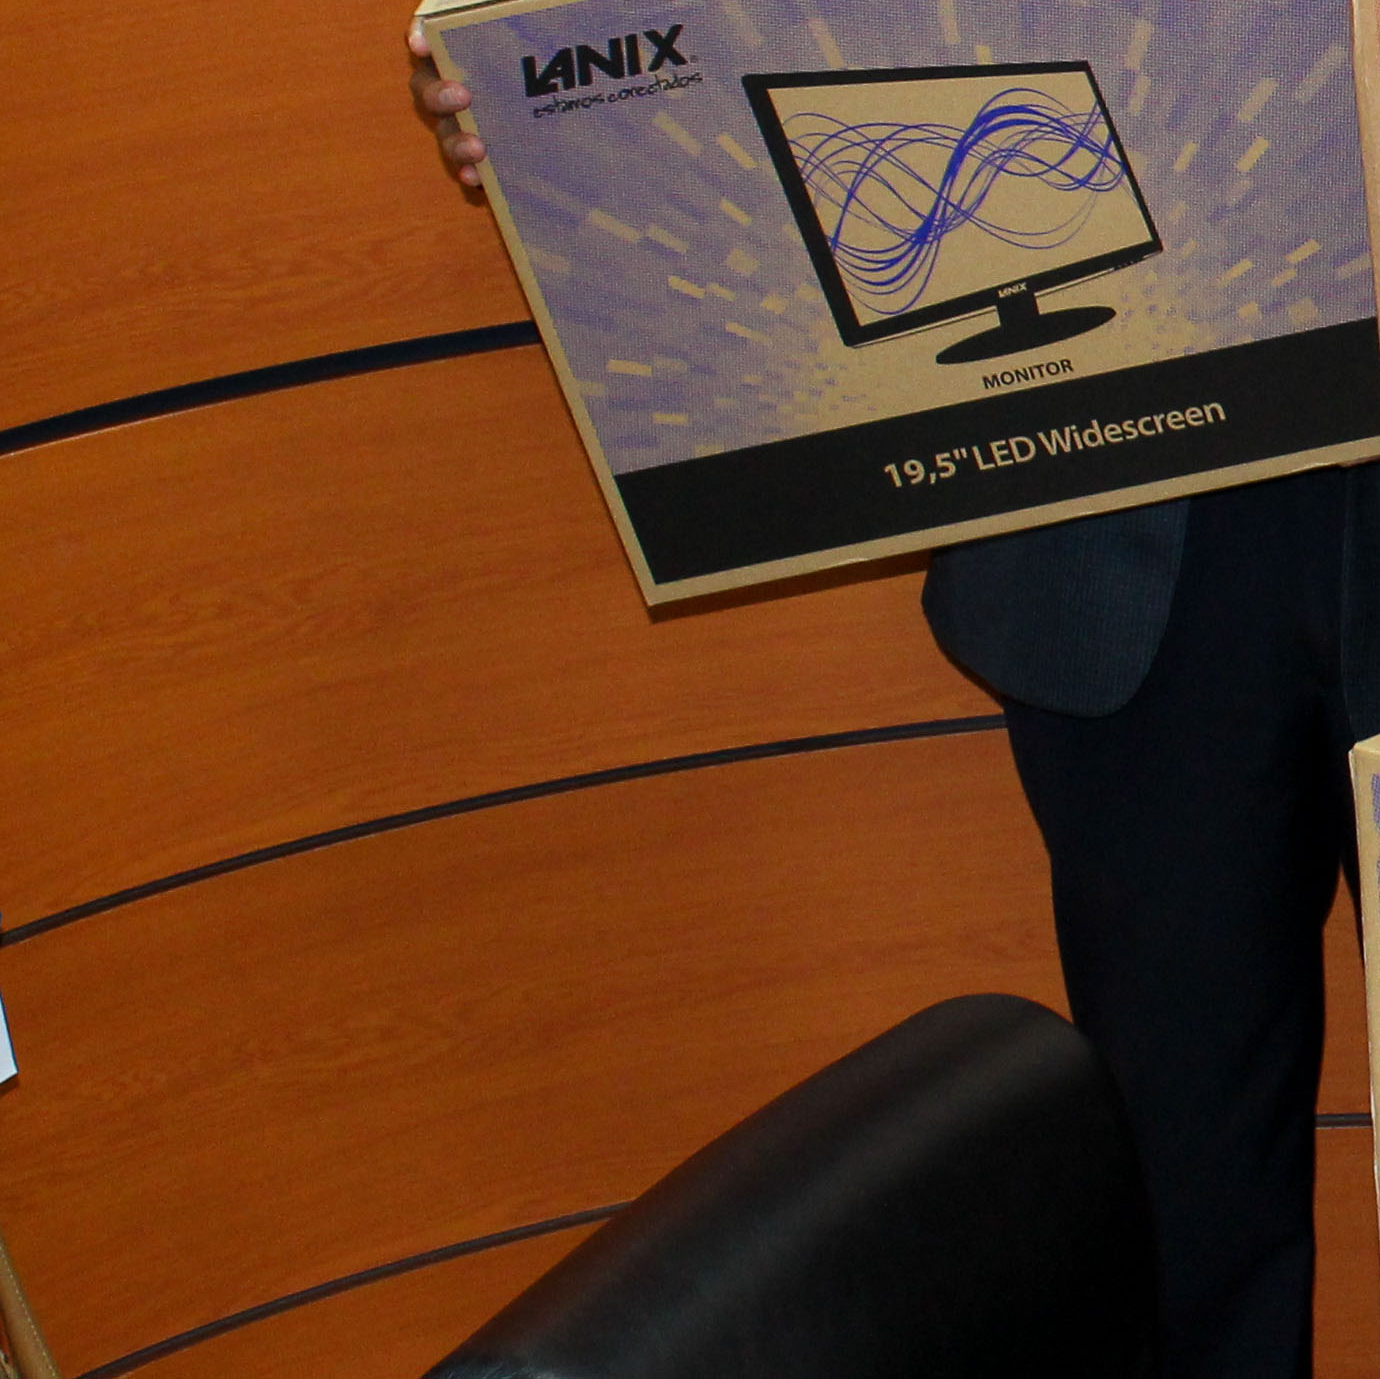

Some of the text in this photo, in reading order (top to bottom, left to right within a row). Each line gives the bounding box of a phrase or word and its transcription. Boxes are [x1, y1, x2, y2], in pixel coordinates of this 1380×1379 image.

[521, 23, 688, 98] LANIX
[982, 358, 1074, 390] MONITOR
[883, 402, 1226, 489] 19,5" LED Widescreen
